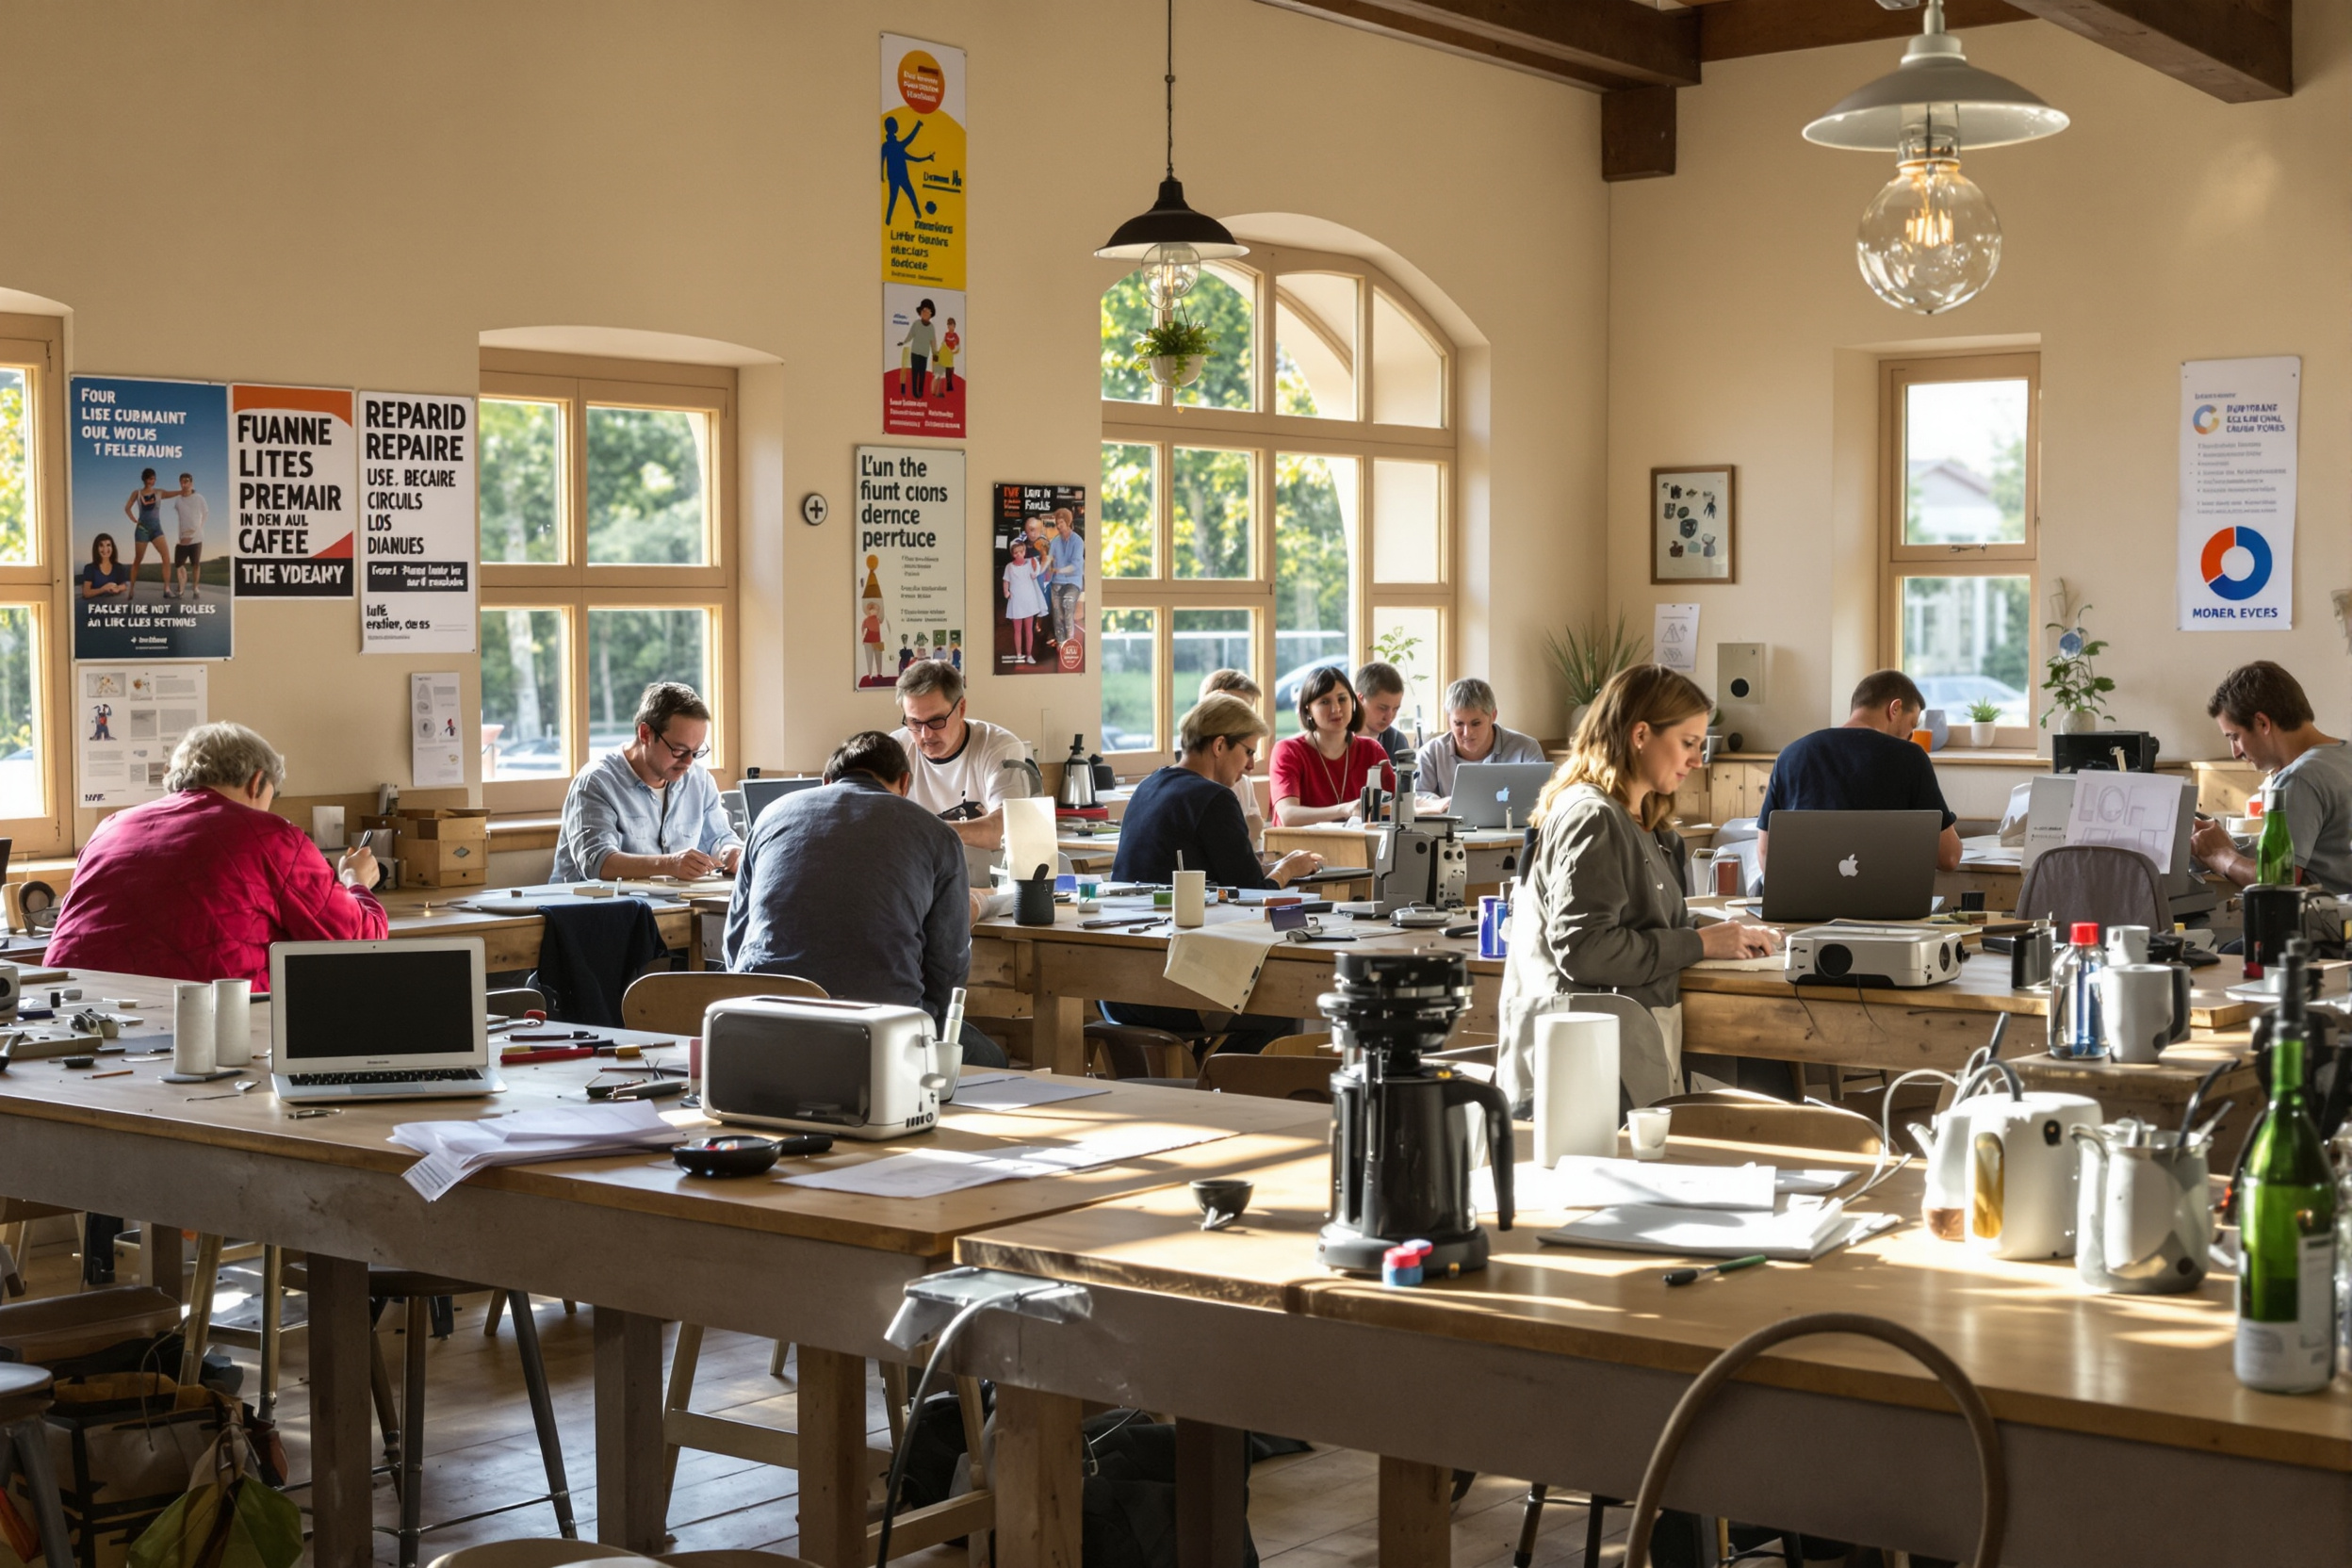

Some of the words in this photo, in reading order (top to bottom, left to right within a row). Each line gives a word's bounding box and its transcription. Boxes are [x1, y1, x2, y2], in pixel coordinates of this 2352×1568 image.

[81, 387, 116, 403] FOUR
[366, 400, 466, 430] REPARID
[237, 415, 332, 446] FUANNE
[366, 433, 464, 461] REPAIRE
[239, 449, 314, 478] LITES
[861, 455, 894, 477] L'un
[899, 456, 927, 477] the
[404, 469, 456, 487] BECAIRE
[239, 482, 342, 511] PREMAIR
[240, 513, 253, 527] IN
[861, 503, 921, 525] dernce
[238, 529, 309, 554] CAFEE
[368, 536, 424, 555] DIANUES
[241, 564, 276, 584] THE
